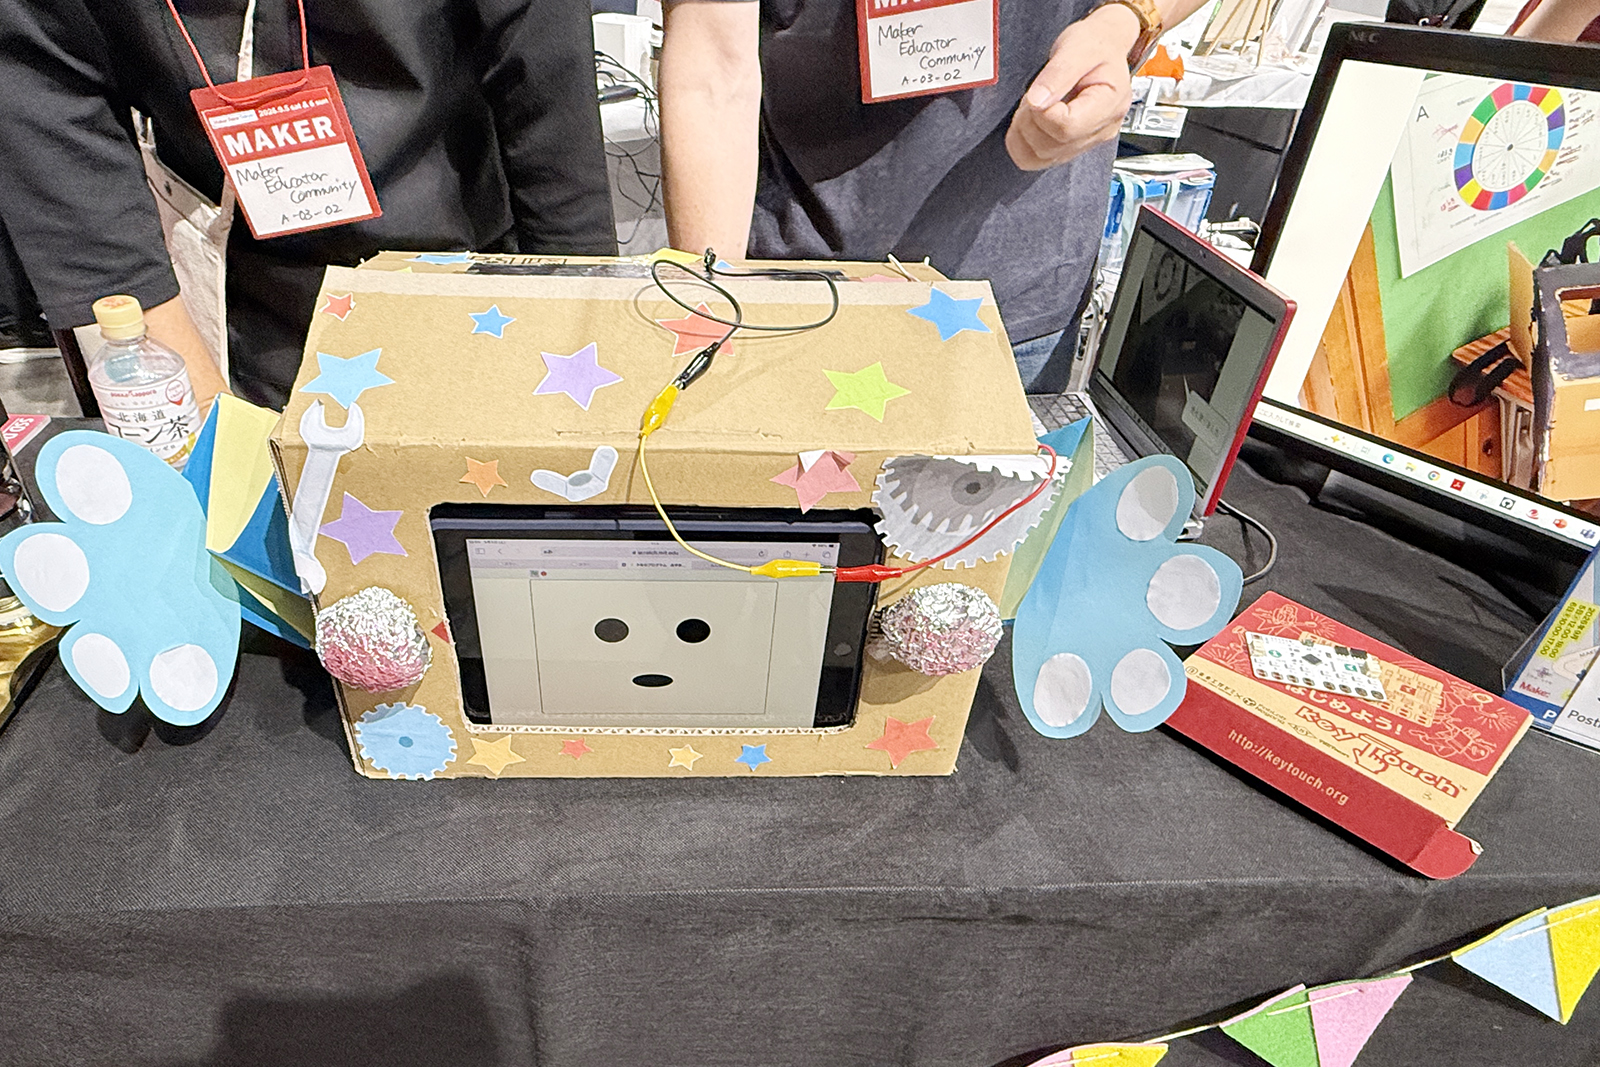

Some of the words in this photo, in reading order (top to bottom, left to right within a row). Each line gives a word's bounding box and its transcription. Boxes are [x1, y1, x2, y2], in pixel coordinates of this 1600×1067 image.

[878, 22, 923, 46] Maker
[1348, 31, 1380, 44] NEC
[899, 38, 957, 56] Educator
[919, 46, 986, 70] Community
[1416, 106, 1429, 122] A
[223, 116, 337, 157] MAKER
[236, 162, 284, 187] Maker
[264, 171, 328, 194] Educator
[290, 178, 357, 204] Community
[118, 409, 166, 423] 北海道
[1228, 729, 1350, 806] http://keytouch.org
